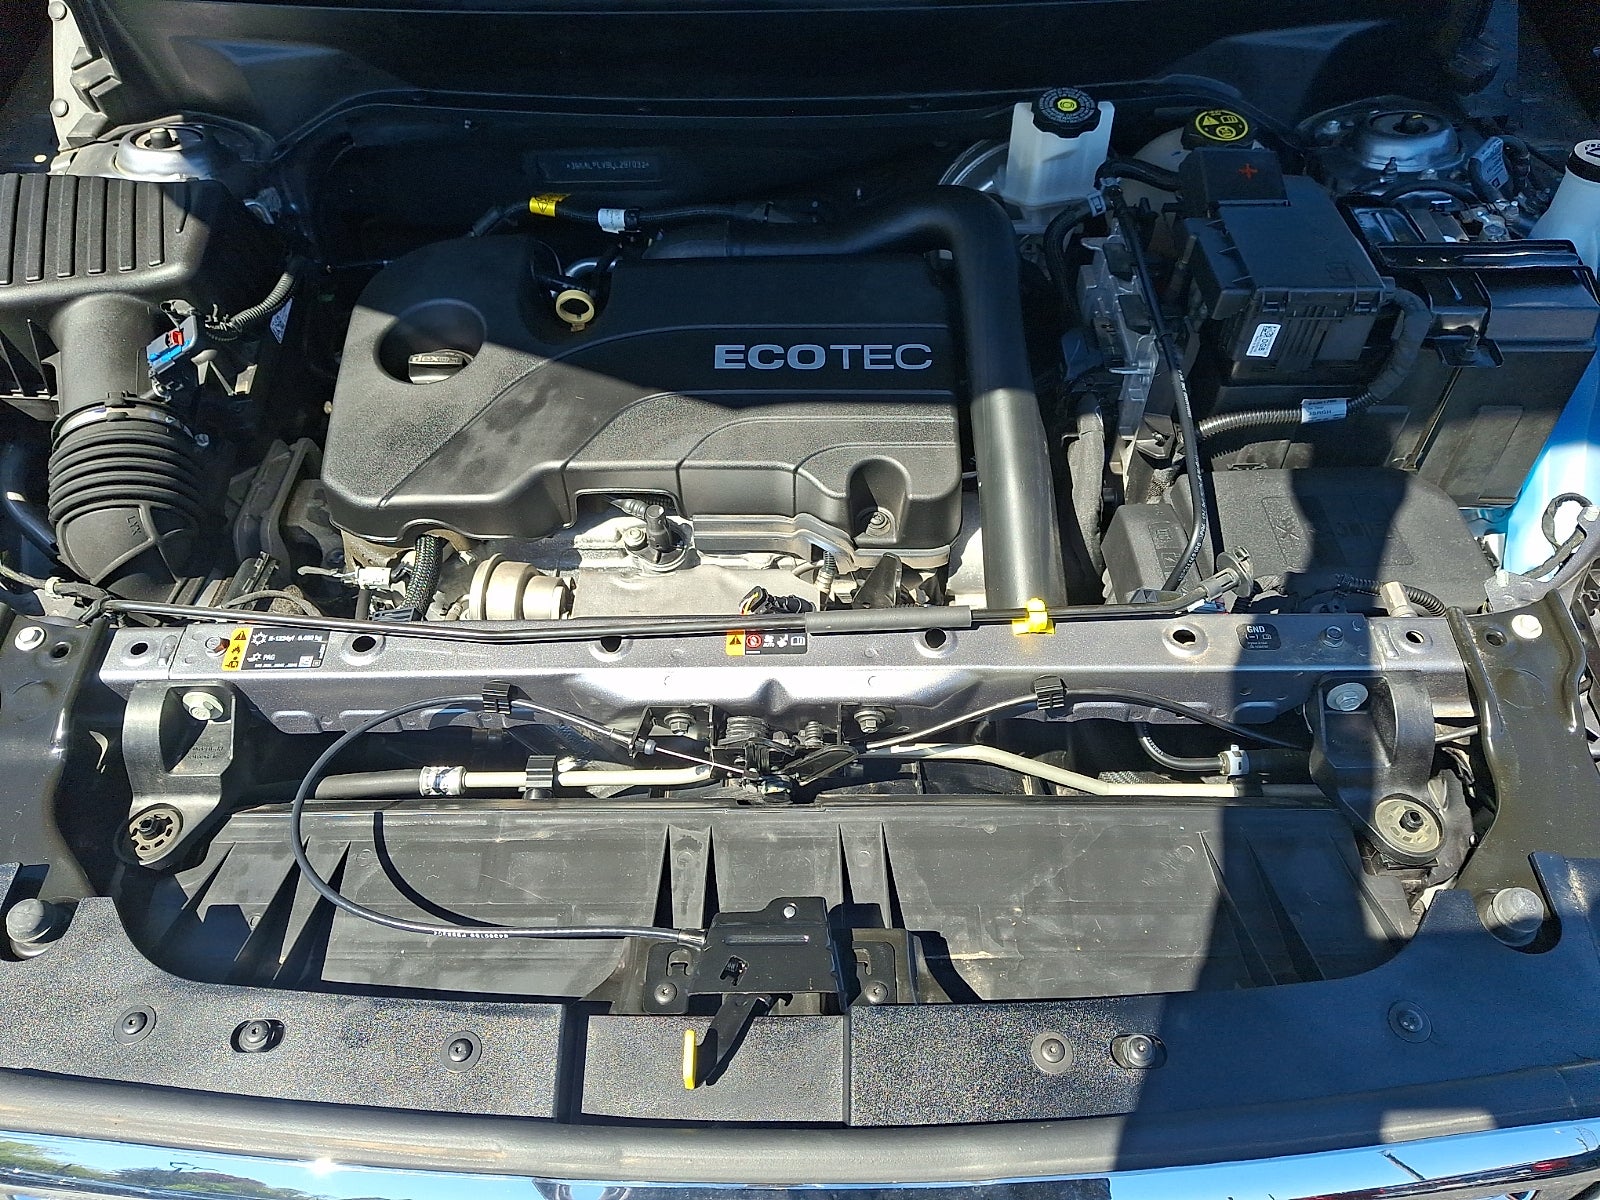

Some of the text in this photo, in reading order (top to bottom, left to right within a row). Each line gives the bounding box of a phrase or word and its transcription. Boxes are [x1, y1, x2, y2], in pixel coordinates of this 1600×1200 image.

[714, 343, 933, 370] ECOTEC
[1246, 625, 1266, 633] GND
[262, 653, 276, 661] PAG
